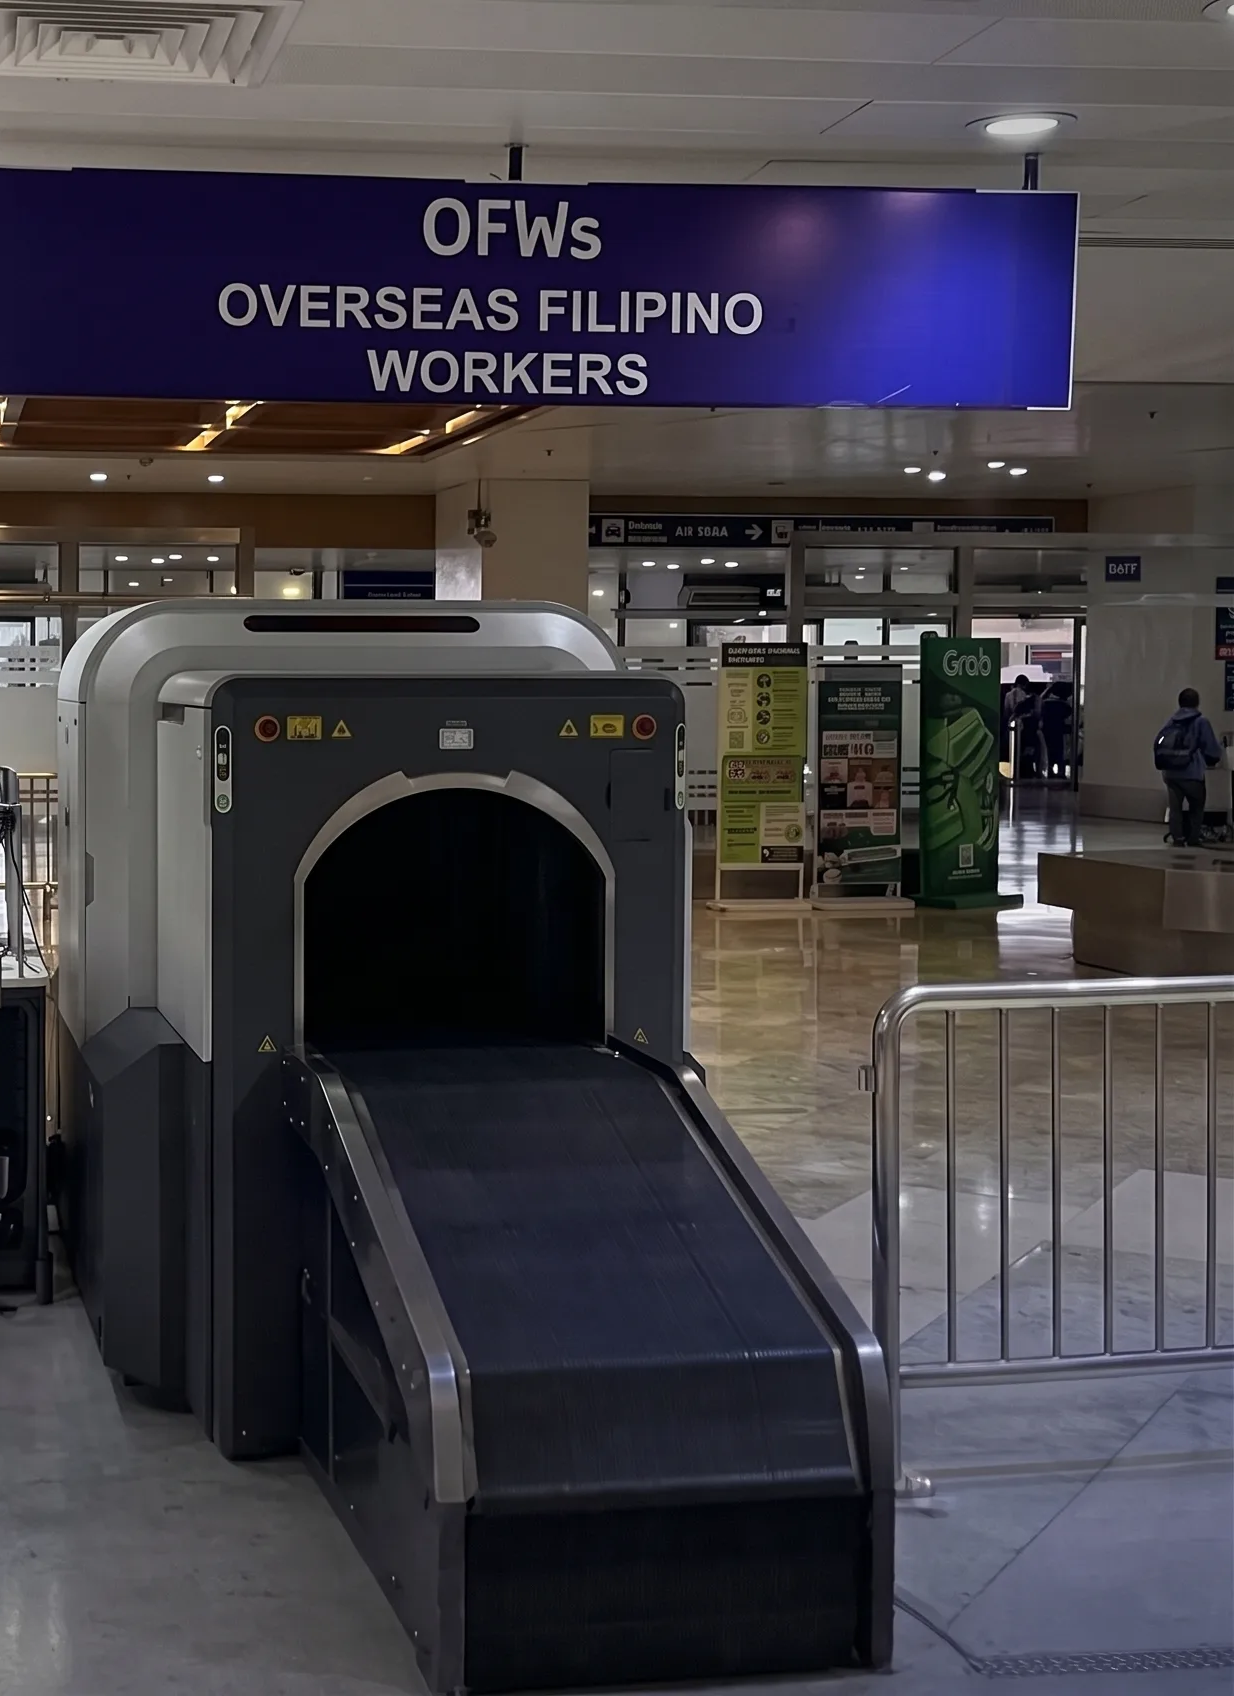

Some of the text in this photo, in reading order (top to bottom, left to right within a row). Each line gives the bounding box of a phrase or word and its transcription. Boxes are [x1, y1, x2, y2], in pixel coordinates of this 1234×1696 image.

[422, 196, 603, 261] OFWs
[217, 281, 764, 336] OVERSEAS FILIPINO
[366, 348, 649, 397] WORKERS
[942, 646, 992, 677] Grab
